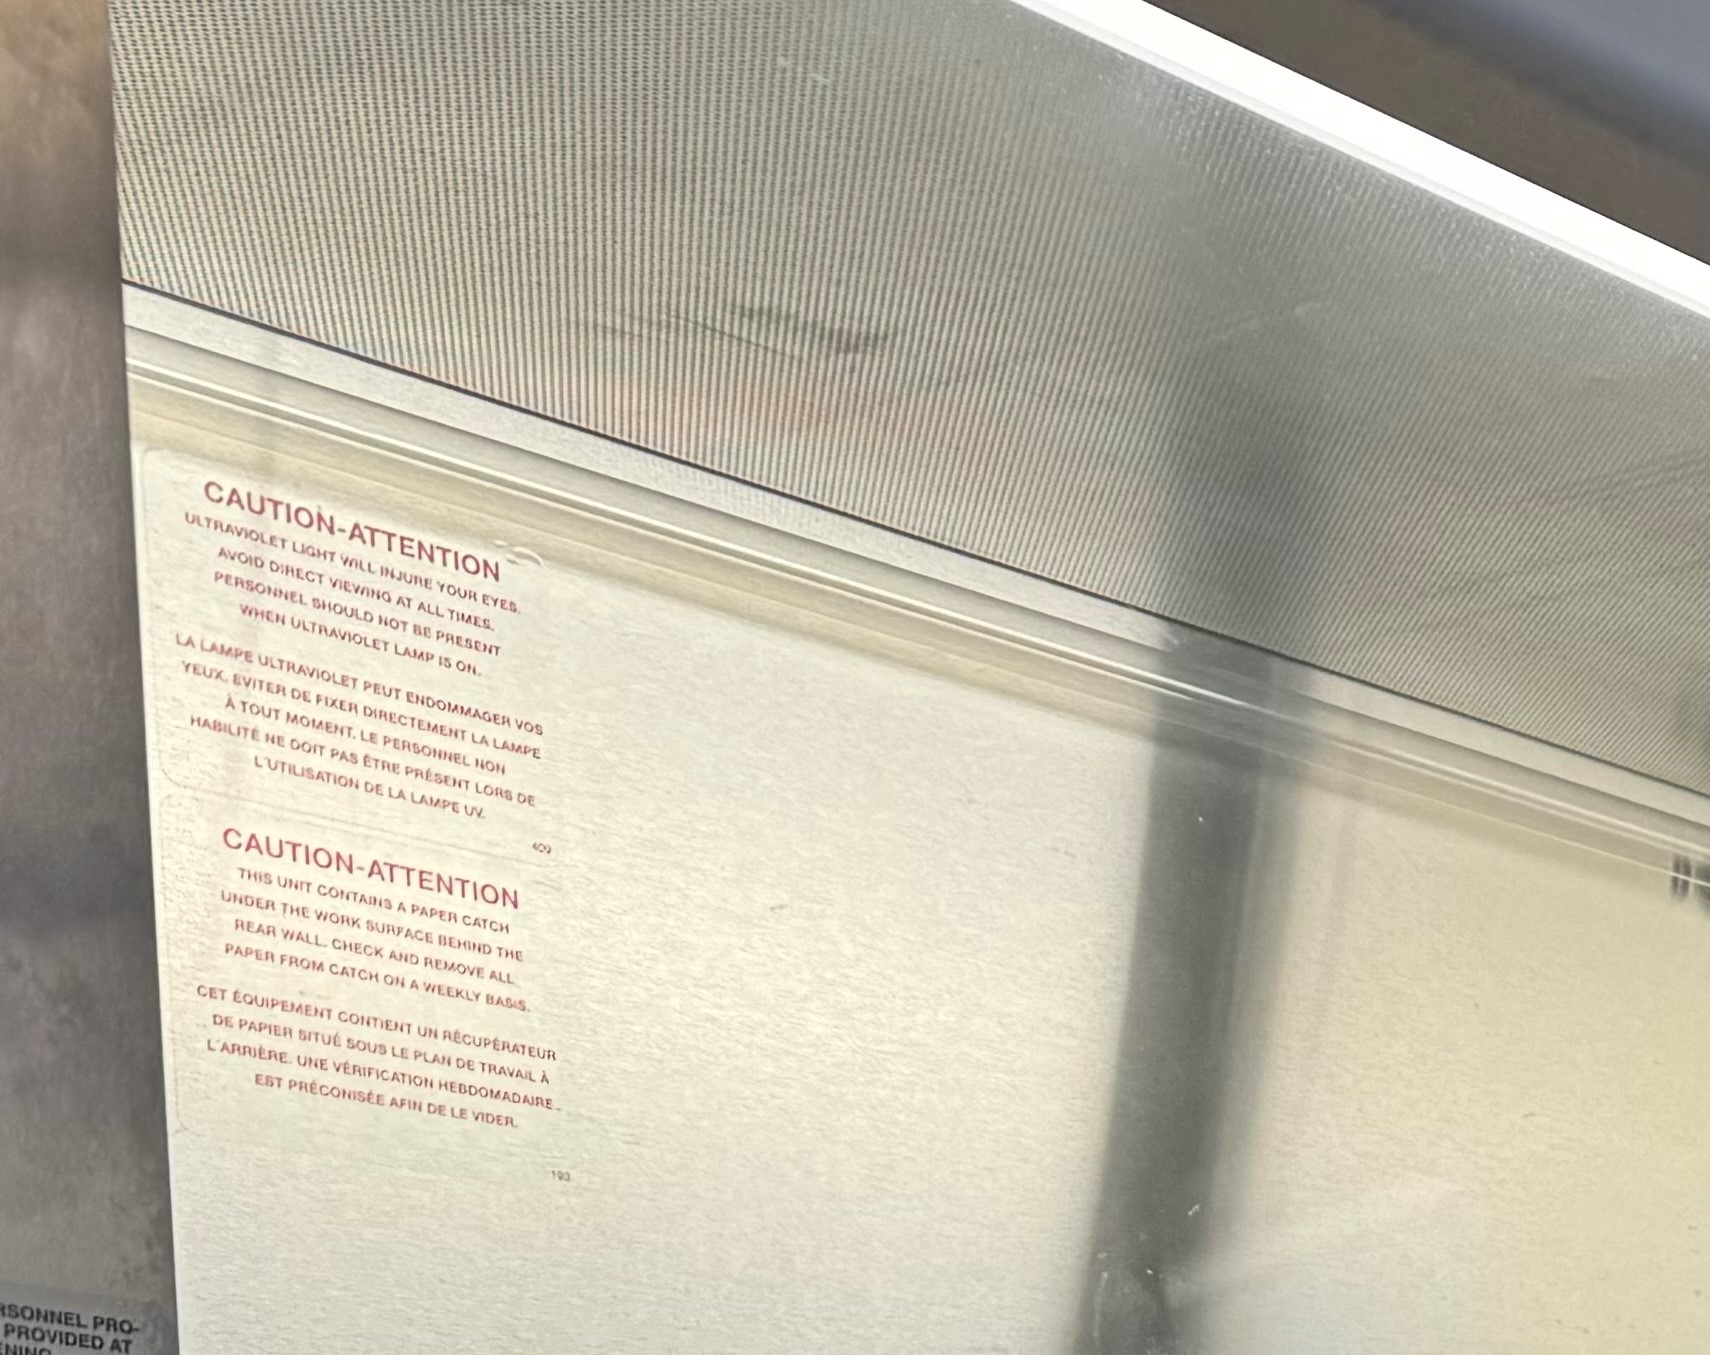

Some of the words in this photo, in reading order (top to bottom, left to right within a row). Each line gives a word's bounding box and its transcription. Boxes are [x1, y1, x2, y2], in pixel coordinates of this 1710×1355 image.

[185, 512, 287, 549] ULTRAVIOLET
[292, 542, 336, 562] LIGHT
[340, 555, 375, 574] WILL
[380, 566, 432, 590] INJURE
[436, 581, 477, 602] YOUR
[482, 594, 520, 613] EYES.
[204, 482, 500, 580] CAUTION-ATTENTION
[214, 572, 307, 605] PERSONNEL
[312, 598, 374, 623] SHOULD
[378, 615, 408, 632] NOT
[413, 624, 431, 639] BE
[436, 631, 501, 656] PRESENT
[218, 548, 264, 568] AVOID
[270, 560, 324, 584] DIRECT
[329, 578, 392, 603] VIEWING
[396, 596, 412, 609] AT
[417, 602, 444, 618] ALL
[448, 609, 494, 631] TIMES.
[240, 604, 285, 625] WHEN
[291, 617, 389, 651] ULTRAVIOLET
[394, 644, 434, 662] LAMP
[438, 656, 452, 668] IS
[456, 660, 481, 676] ON.
[176, 634, 195, 648] LA
[200, 640, 253, 663] LAMPE
[258, 655, 358, 688] ULTRAVIOLET
[363, 681, 401, 700] PEUT
[406, 692, 511, 726] ENDOMMAGER
[515, 719, 543, 736] VOS
[223, 829, 518, 908] CAUTION-ATTENTION
[238, 867, 272, 885] THIS
[278, 876, 312, 893] UNIT
[317, 885, 392, 910] CONTAINS
[397, 902, 406, 913] A
[411, 904, 458, 923] PAPER
[462, 915, 509, 934] CATCH
[221, 890, 276, 911] UNDER
[282, 903, 309, 918] THE
[314, 910, 360, 928] WORK
[366, 920, 433, 943] SURFACE
[438, 935, 492, 955] BEHIND
[497, 947, 523, 962] THE
[235, 919, 276, 937] REAR
[332, 939, 383, 958] CHECK
[389, 950, 419, 965] AND
[424, 957, 484, 978] REMOVE
[489, 970, 514, 984] ALL
[225, 943, 274, 962] PAPER
[280, 954, 324, 972] FROM
[329, 963, 379, 982] CATCH
[384, 974, 405, 988] ON
[410, 979, 419, 990] A
[423, 982, 480, 1001] WEEKLY
[4, 1324, 105, 1350] PROVIDED
[110, 1338, 132, 1354] AT
[93, 1316, 140, 1335] PRO-
